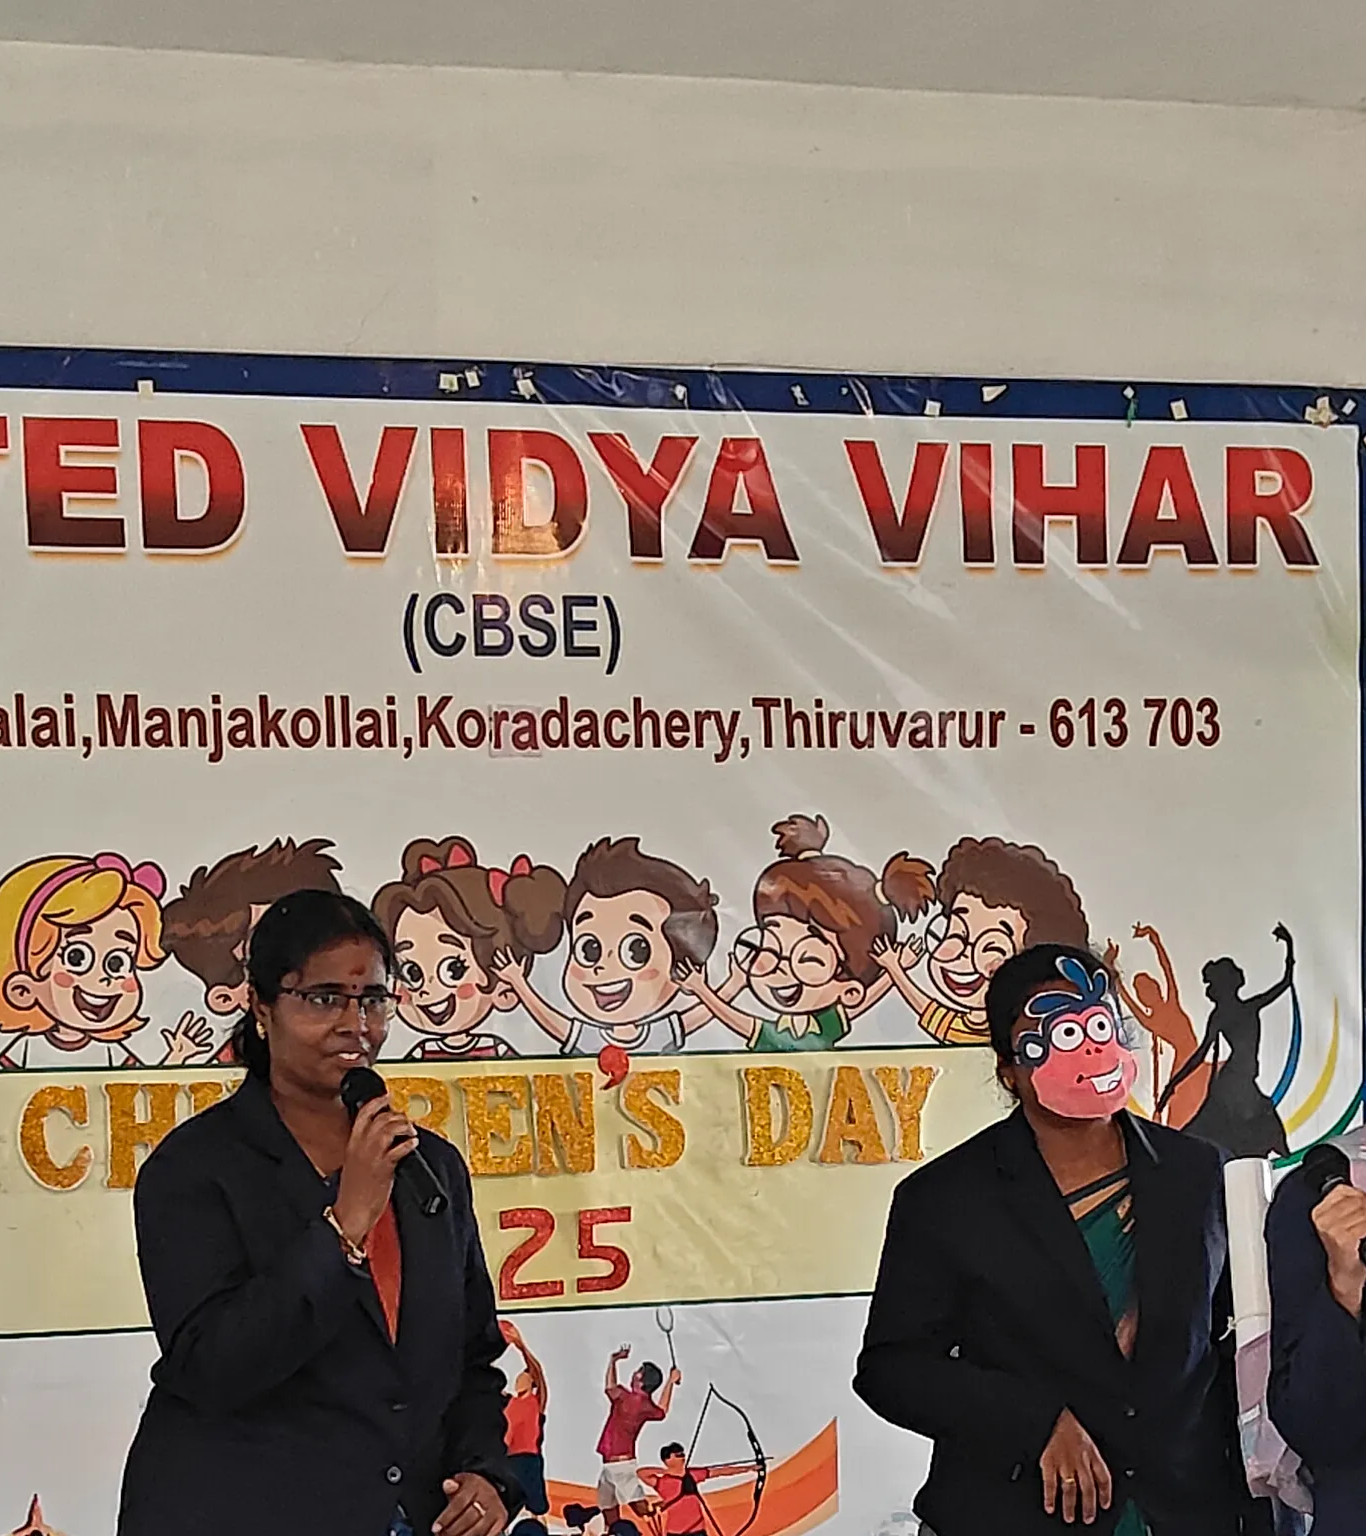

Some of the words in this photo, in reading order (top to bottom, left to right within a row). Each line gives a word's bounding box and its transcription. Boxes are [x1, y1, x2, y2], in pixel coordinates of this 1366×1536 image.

[301, 420, 800, 565] VIDYA
[844, 438, 1320, 569] VIHAR
[403, 592, 622, 673] (CBSE)
[1049, 697, 1129, 749] 613
[1143, 697, 1222, 749] 703
[742, 1065, 937, 1167] DAY
